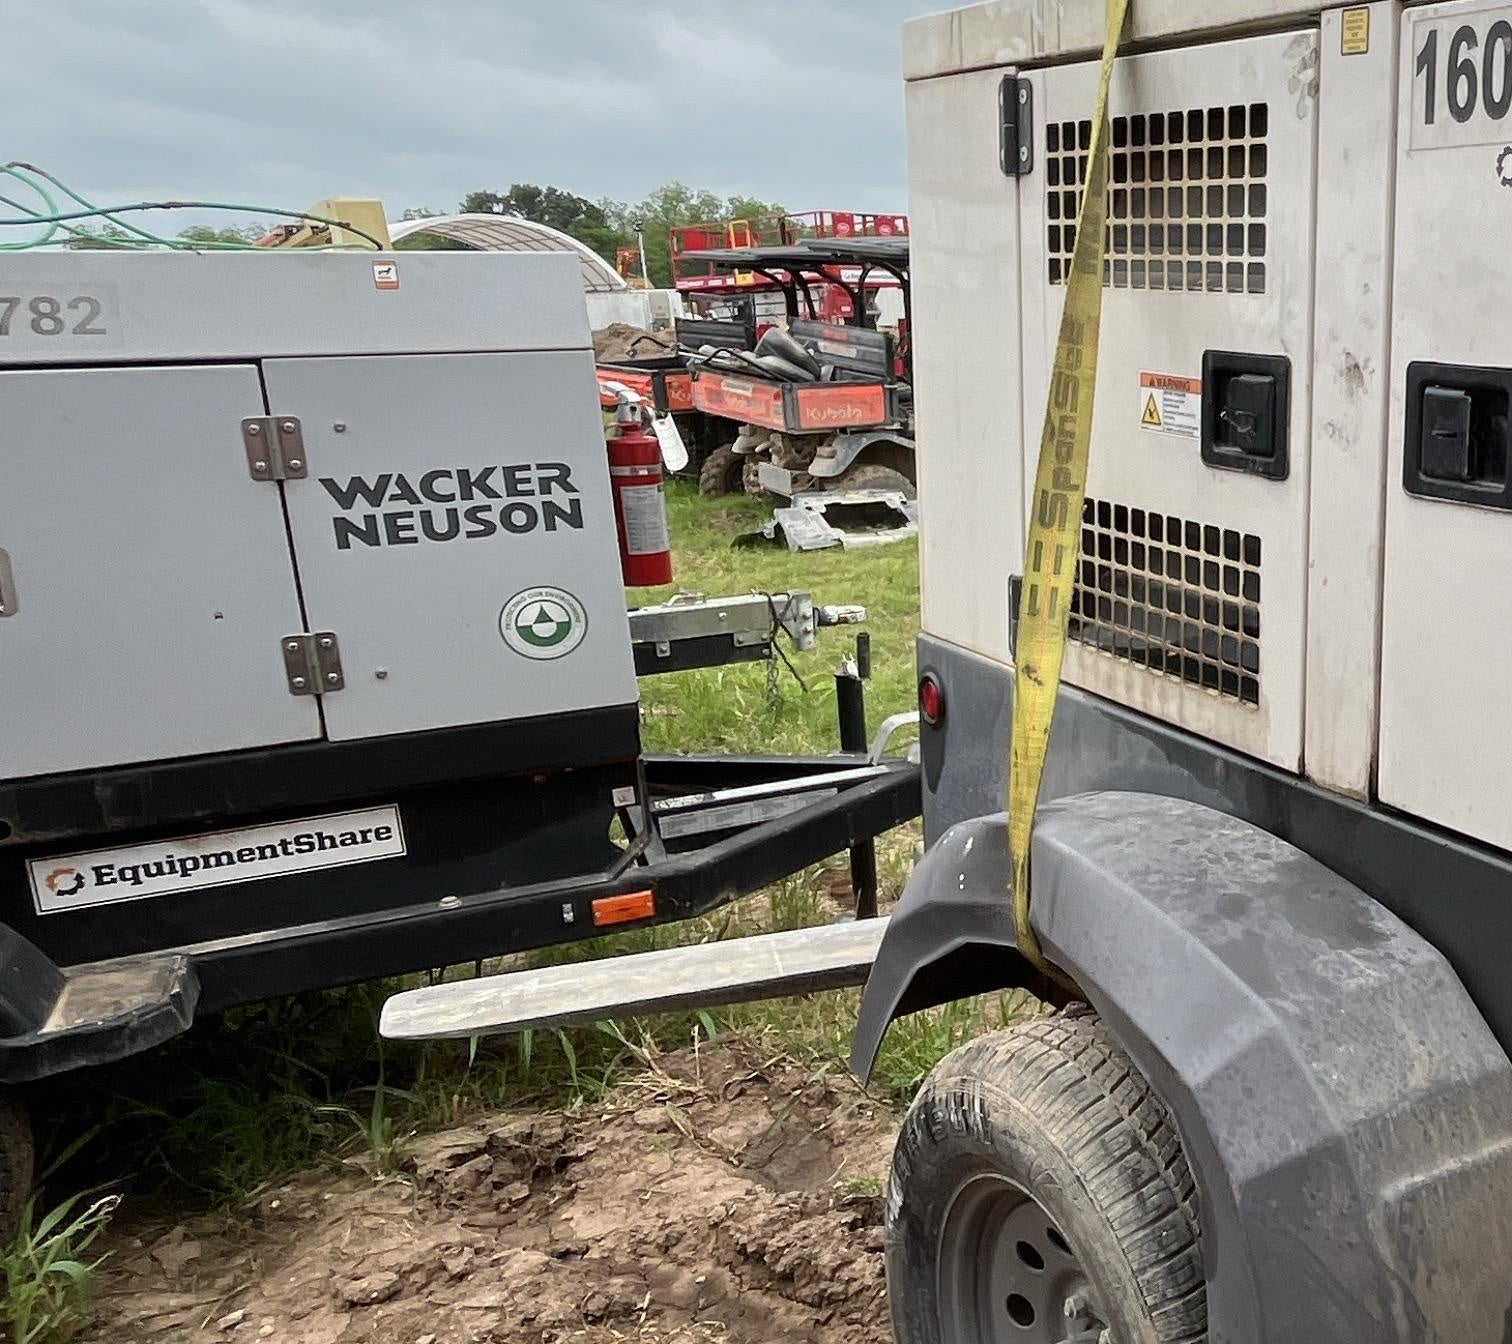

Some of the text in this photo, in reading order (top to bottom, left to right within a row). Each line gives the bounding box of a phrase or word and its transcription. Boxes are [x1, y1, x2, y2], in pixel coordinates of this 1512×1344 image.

[0, 295, 107, 336] 782
[318, 462, 580, 510] WACKER
[333, 498, 584, 549] NEUSON
[91, 824, 393, 888] EquipmentShare
